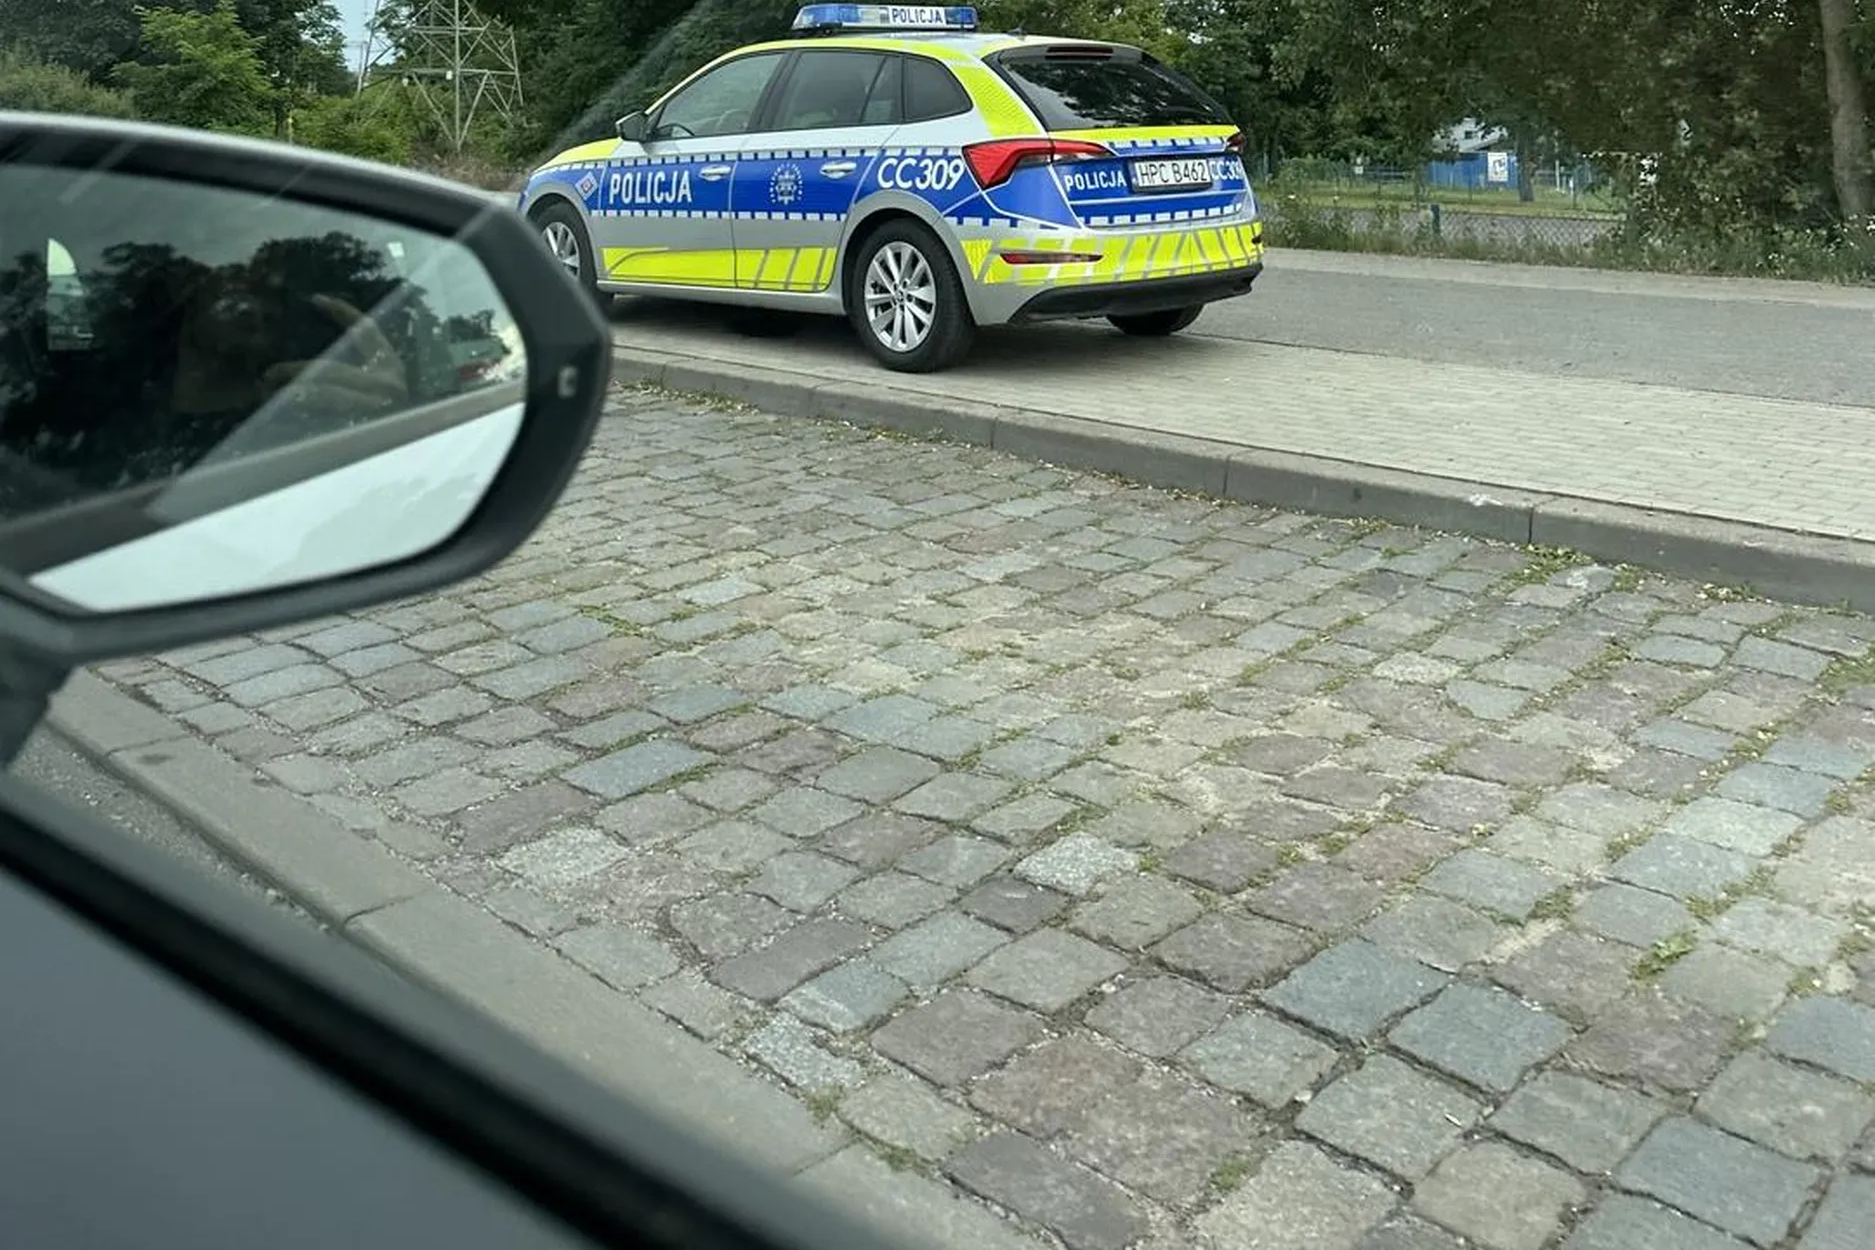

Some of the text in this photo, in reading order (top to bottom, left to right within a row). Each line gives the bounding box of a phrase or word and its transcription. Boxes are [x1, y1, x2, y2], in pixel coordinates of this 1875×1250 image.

[891, 8, 944, 24] POLICJA
[877, 158, 964, 191] CC309
[1064, 170, 1127, 191] POLICJA
[1139, 160, 1207, 185] HPC B462
[608, 170, 692, 205] POLICJA
